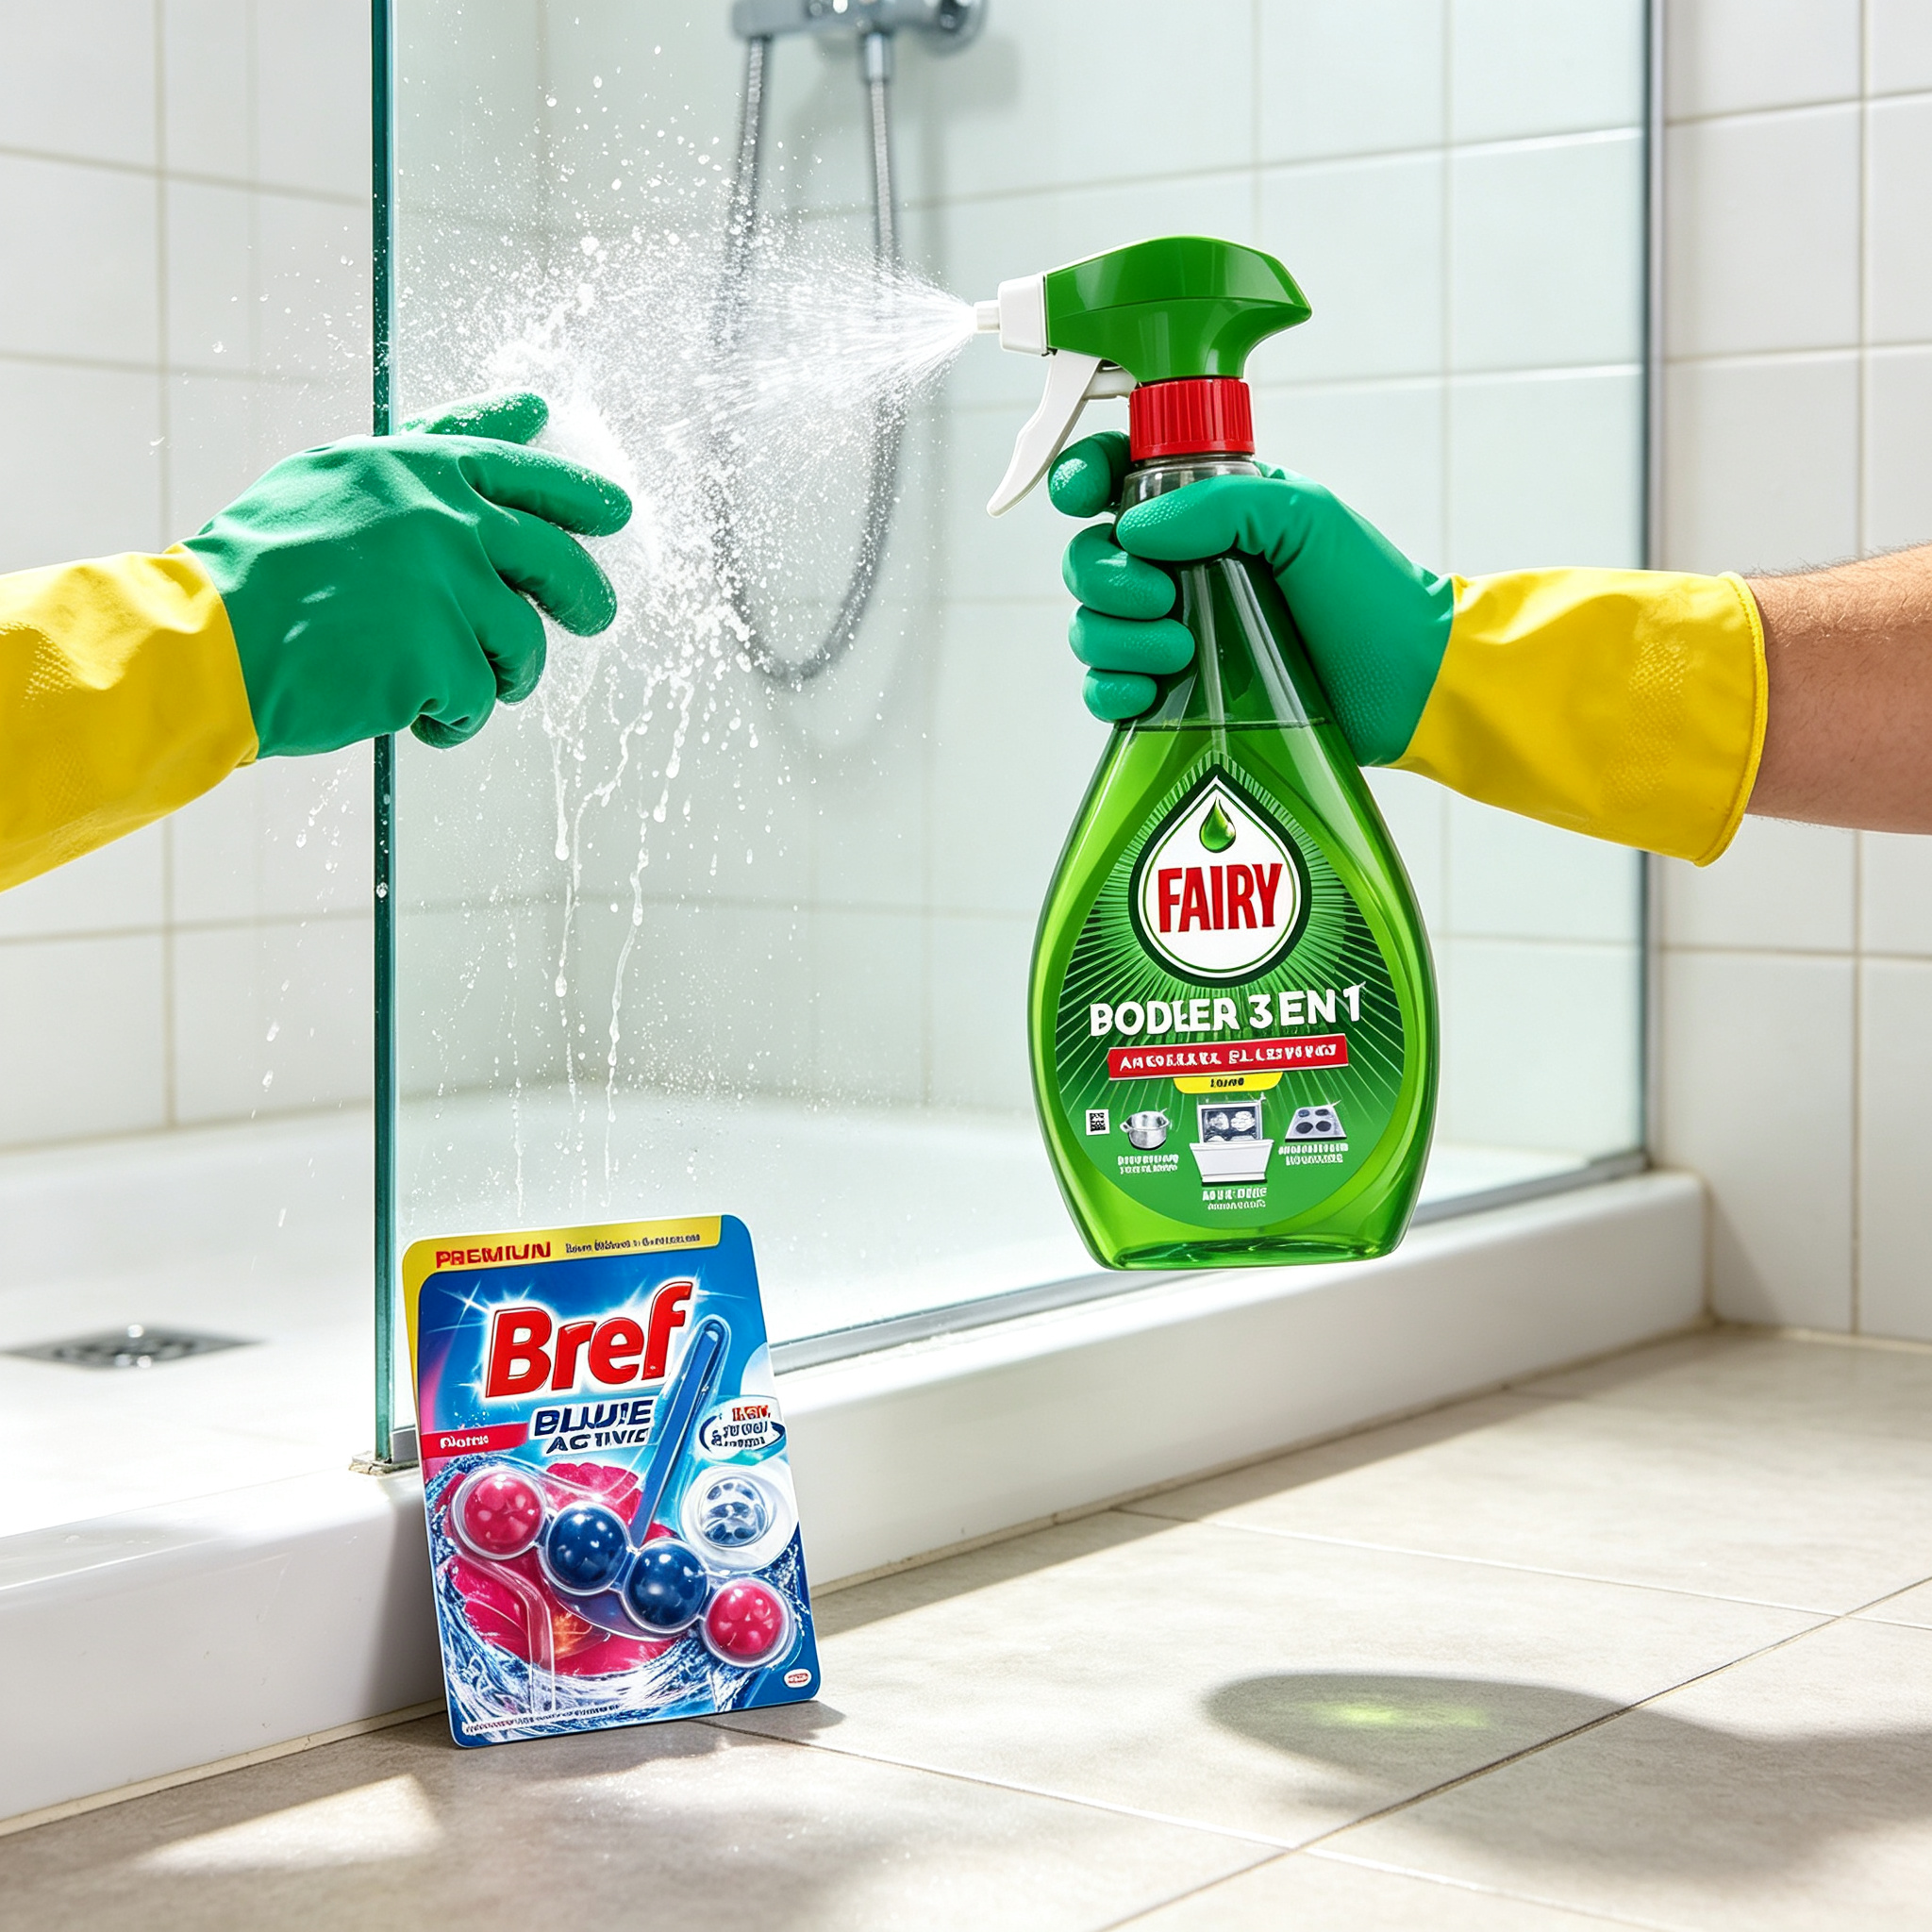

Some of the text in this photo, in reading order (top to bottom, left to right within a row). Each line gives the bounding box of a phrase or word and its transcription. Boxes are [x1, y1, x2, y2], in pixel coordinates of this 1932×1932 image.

[1158, 862, 1283, 933] FAIRY
[1249, 993, 1274, 1029] 3
[485, 1281, 693, 1398] Bref
